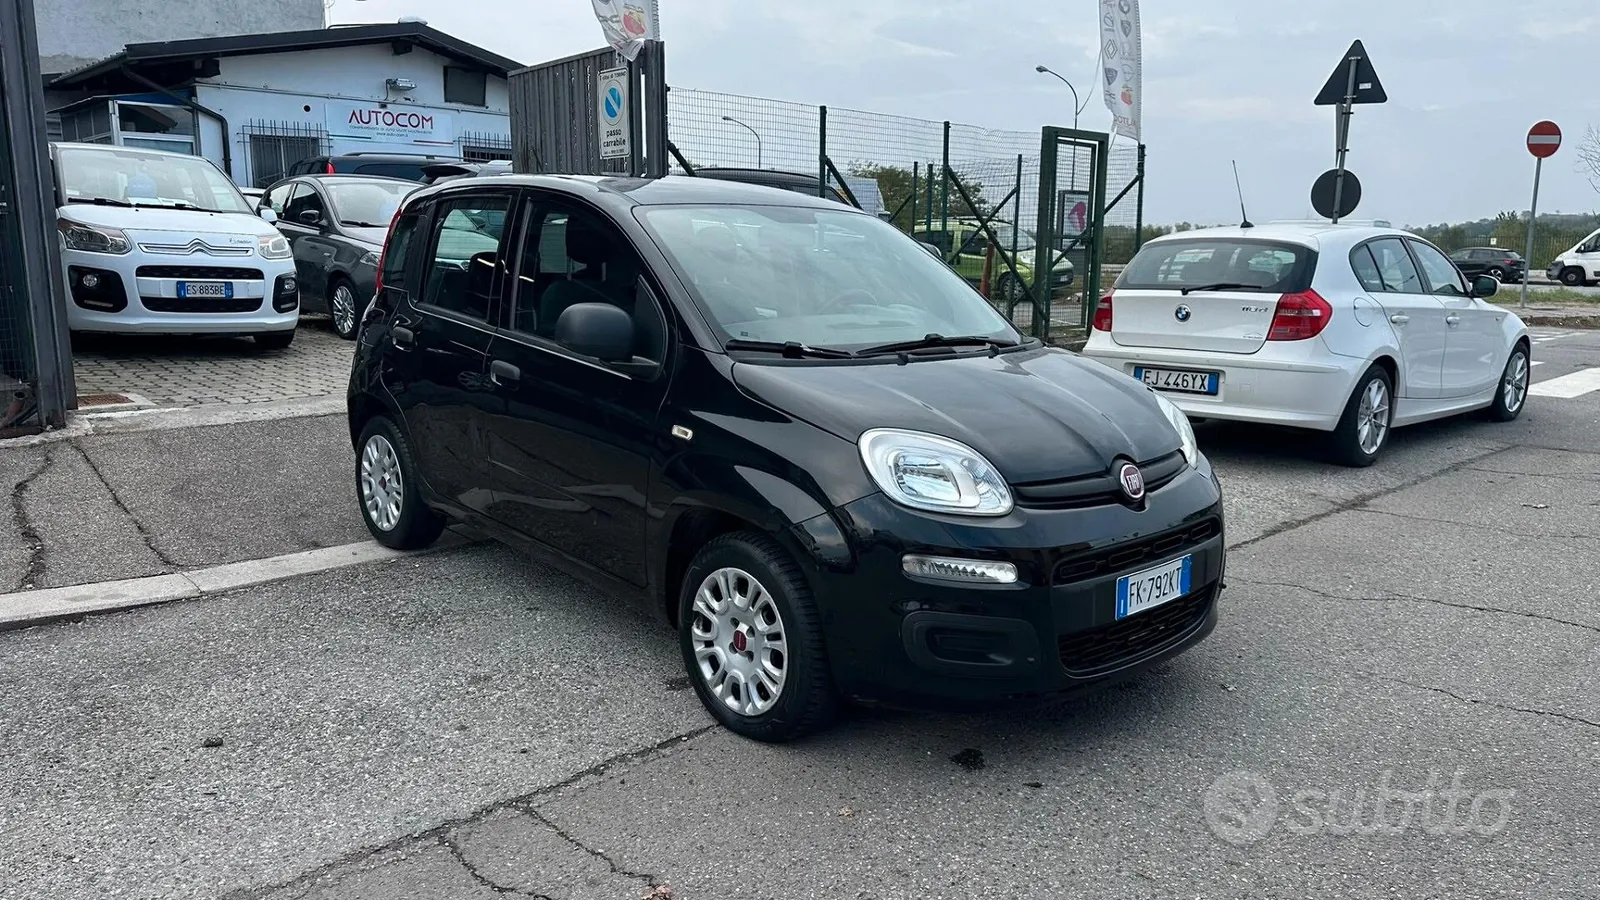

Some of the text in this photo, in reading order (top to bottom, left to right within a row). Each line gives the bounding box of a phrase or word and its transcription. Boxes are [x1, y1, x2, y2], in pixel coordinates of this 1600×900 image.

[348, 109, 434, 130] AUTOCOM
[606, 129, 622, 138] passo
[603, 138, 626, 148] carrabile
[1126, 473, 1141, 491] FIAT
